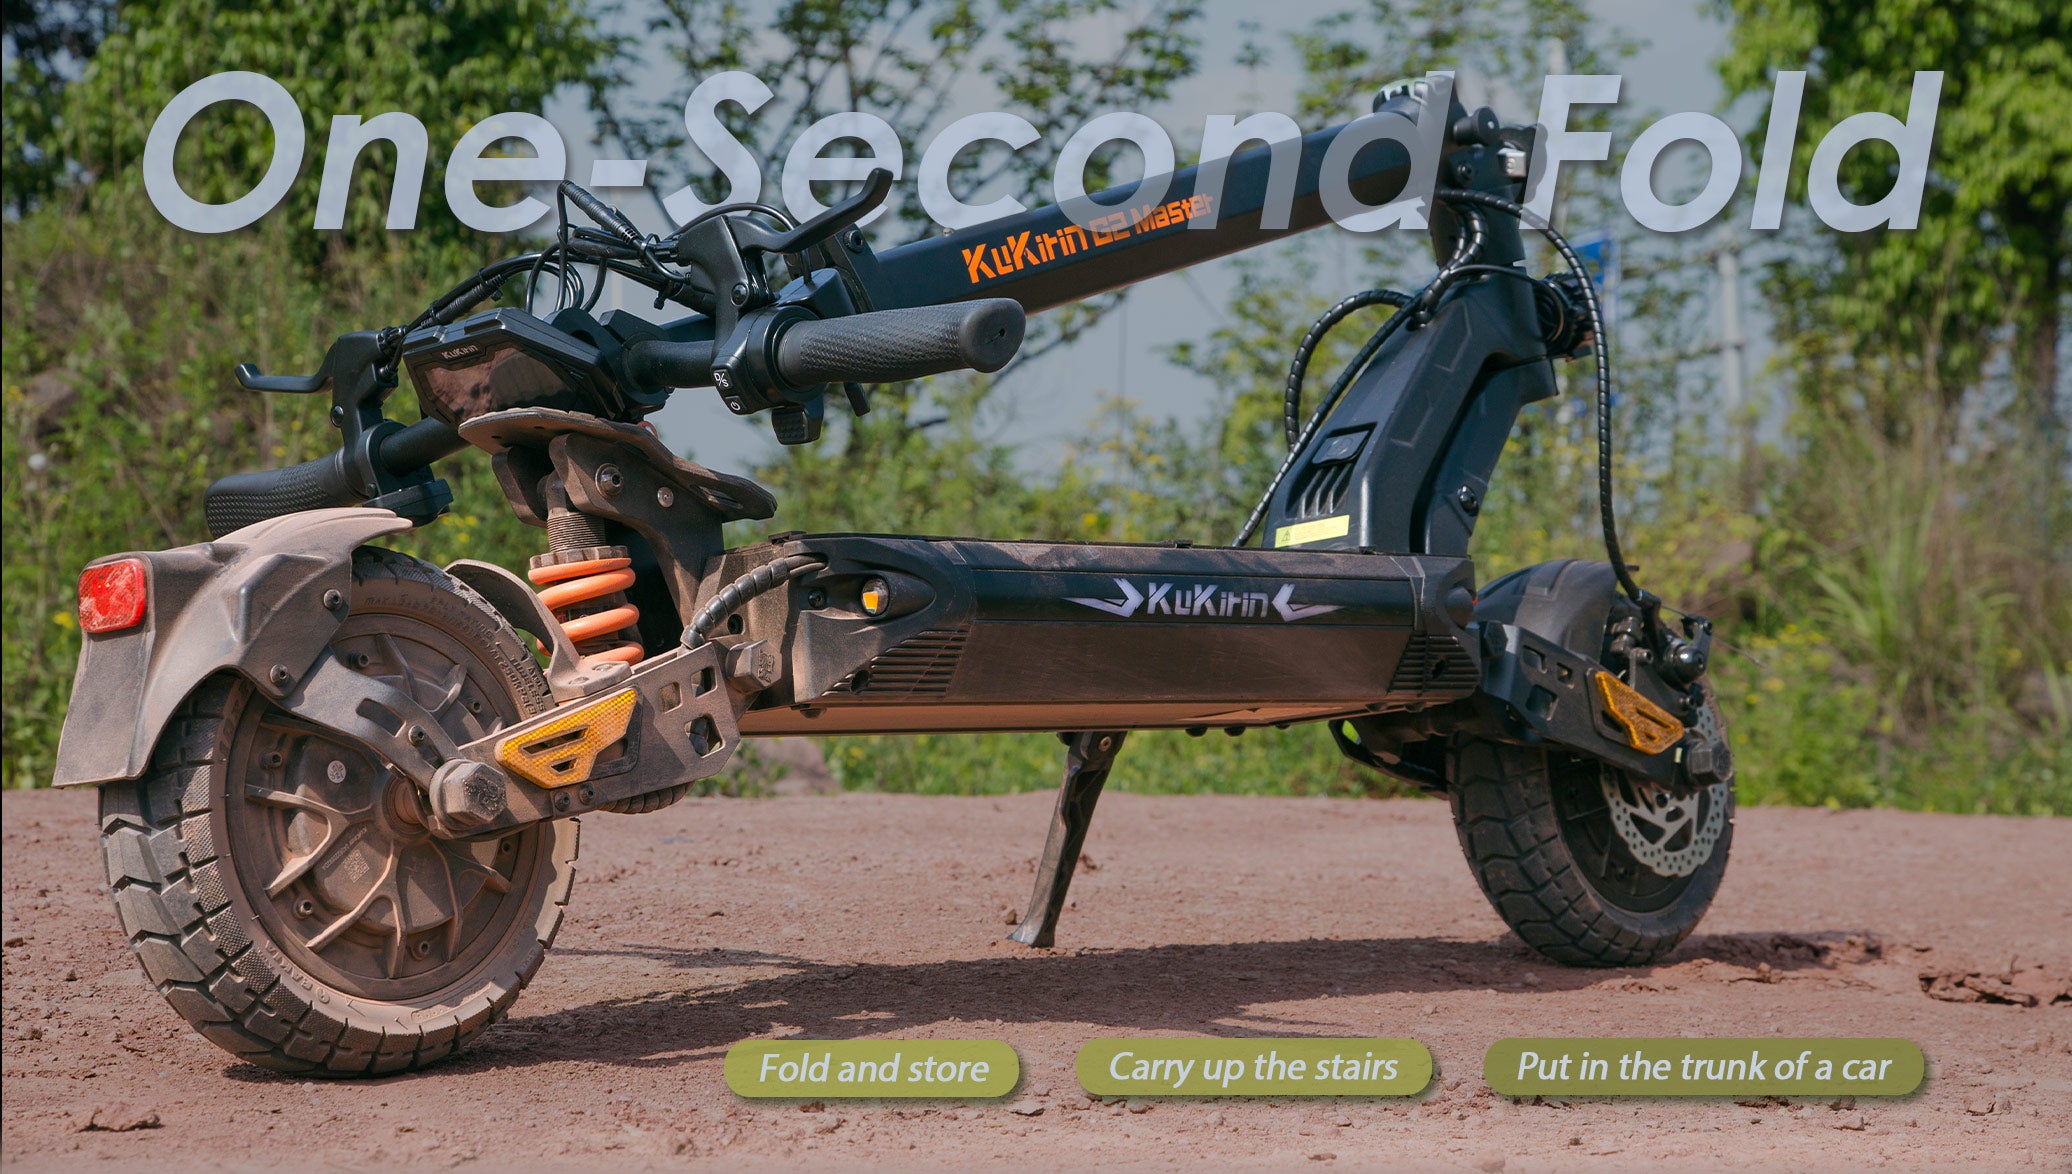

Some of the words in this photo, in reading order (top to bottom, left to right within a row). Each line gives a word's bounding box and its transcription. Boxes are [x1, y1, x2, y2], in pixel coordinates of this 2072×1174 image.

[962, 224, 1088, 283] KuKirin
[1088, 211, 1130, 247] G2
[1131, 193, 1214, 234] Master
[441, 344, 478, 359] KuKirin
[713, 372, 729, 387] D/S
[1146, 582, 1269, 618] KuKirin
